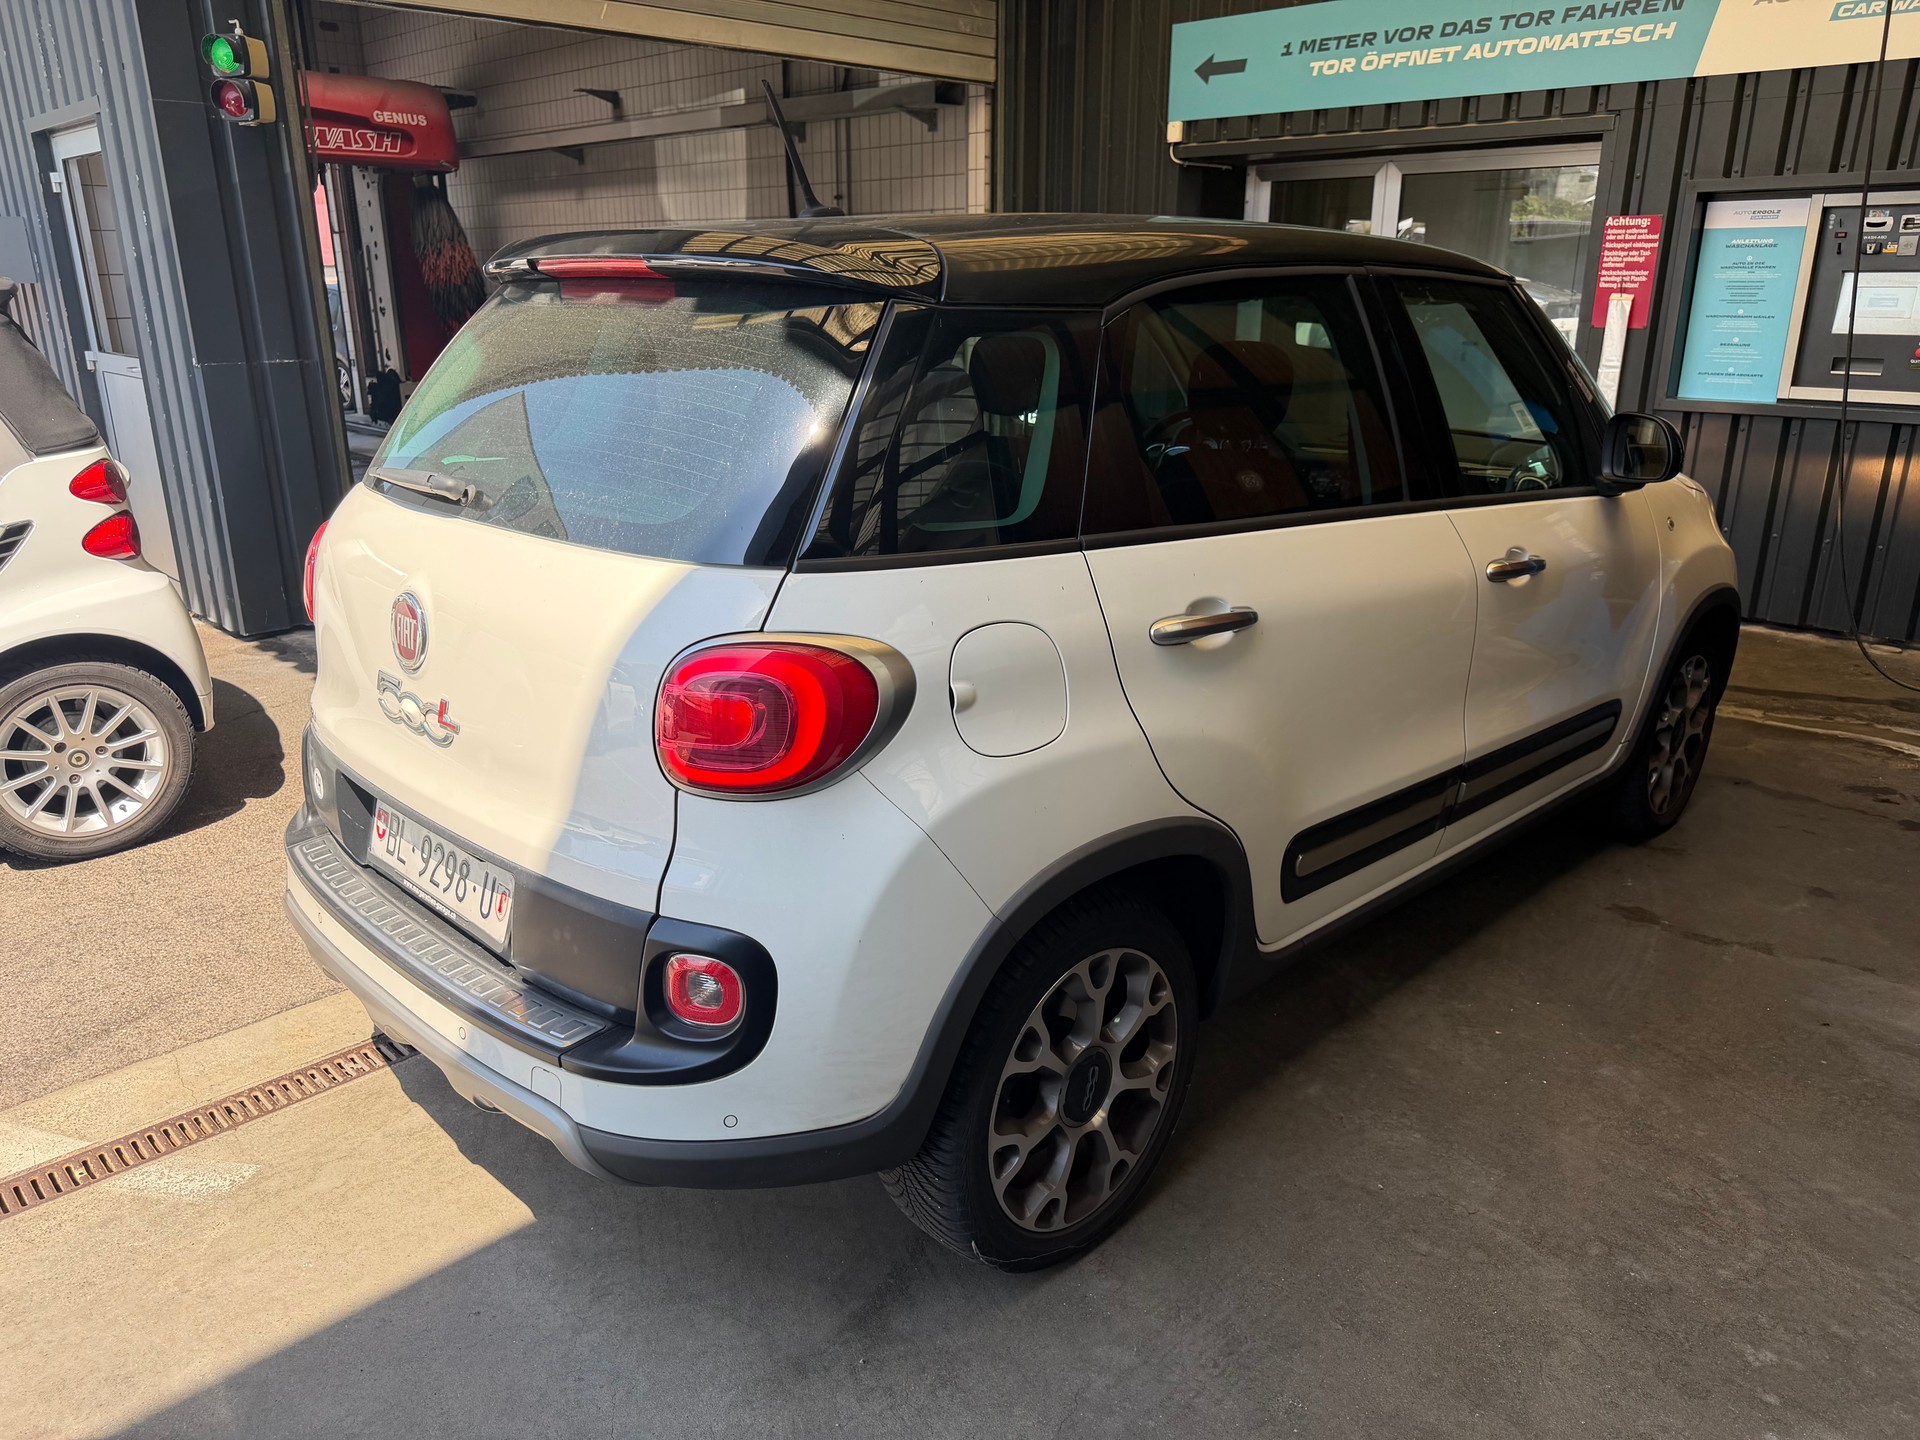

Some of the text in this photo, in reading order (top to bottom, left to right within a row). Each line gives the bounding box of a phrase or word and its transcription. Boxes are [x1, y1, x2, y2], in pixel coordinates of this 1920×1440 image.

[1837, 0, 1883, 17] CAR
[1281, 0, 1686, 56] 1 METER VOR DAS TOR FAHREN
[1309, 21, 1677, 77] TOR ÖFFNET AUTOMATISCH
[373, 110, 428, 126] GENIUS
[1606, 216, 1651, 227] Achtung:
[396, 613, 417, 650] FIAT
